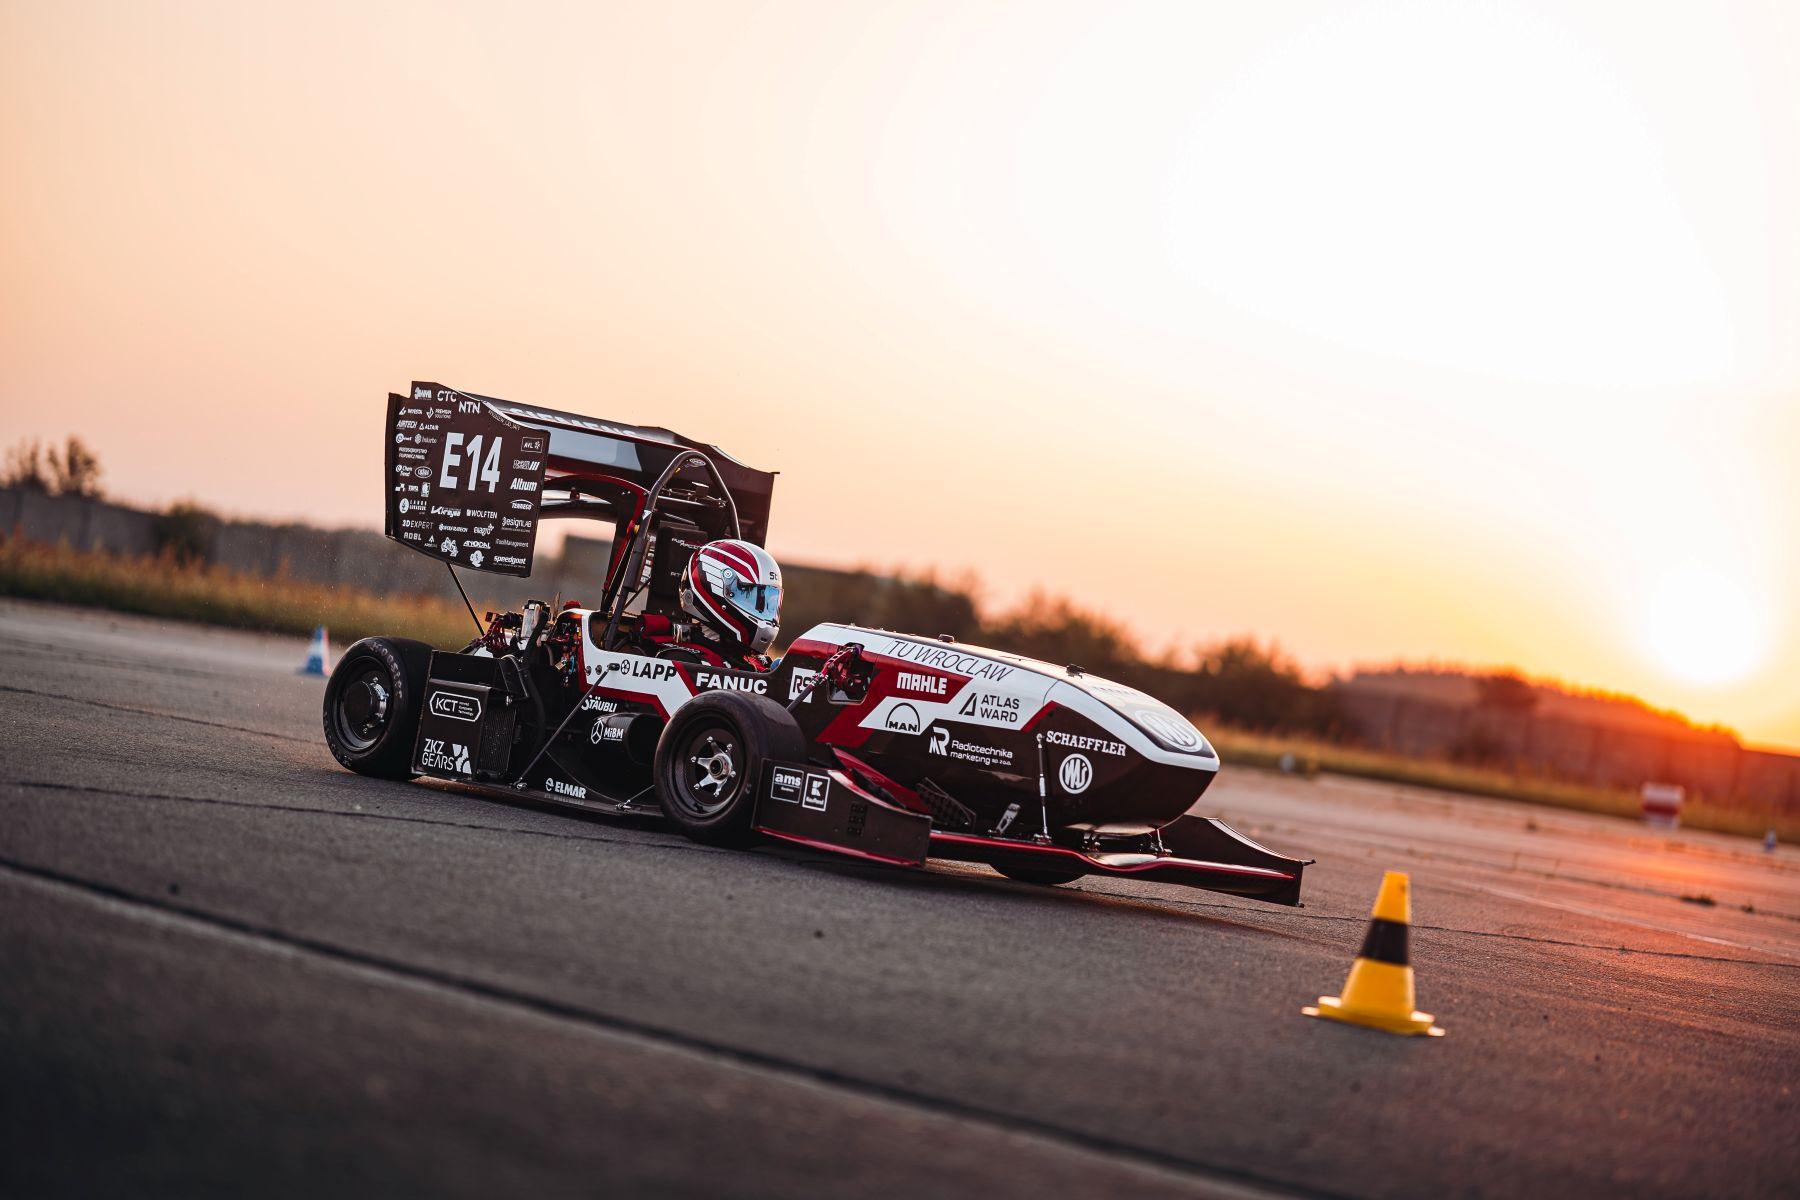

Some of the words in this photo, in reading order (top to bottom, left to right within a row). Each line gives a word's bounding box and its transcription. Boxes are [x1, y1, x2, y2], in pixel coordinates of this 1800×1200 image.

[437, 390, 458, 402] CTC
[458, 401, 481, 414] NTN
[440, 432, 503, 493] E14
[471, 509, 498, 519] WOLFTEN
[888, 640, 917, 657] TU
[914, 648, 1014, 682] WROCLAW
[632, 660, 678, 681] LAPP
[696, 672, 768, 695] FANUC
[896, 672, 948, 695] MAHLE
[435, 697, 458, 712] KCT
[581, 695, 618, 713] STÄUBLI
[981, 694, 1020, 710] ATLAS
[980, 706, 1018, 723] WARD
[888, 720, 919, 732] MAN
[424, 738, 445, 754] ZKZ
[951, 739, 1013, 758] Radiotechnika
[1046, 730, 1127, 756] SCHAEFFLER
[421, 751, 455, 771] GEARS
[950, 751, 991, 765] marketing
[774, 773, 802, 788] ams
[554, 781, 587, 799] ELMAR
